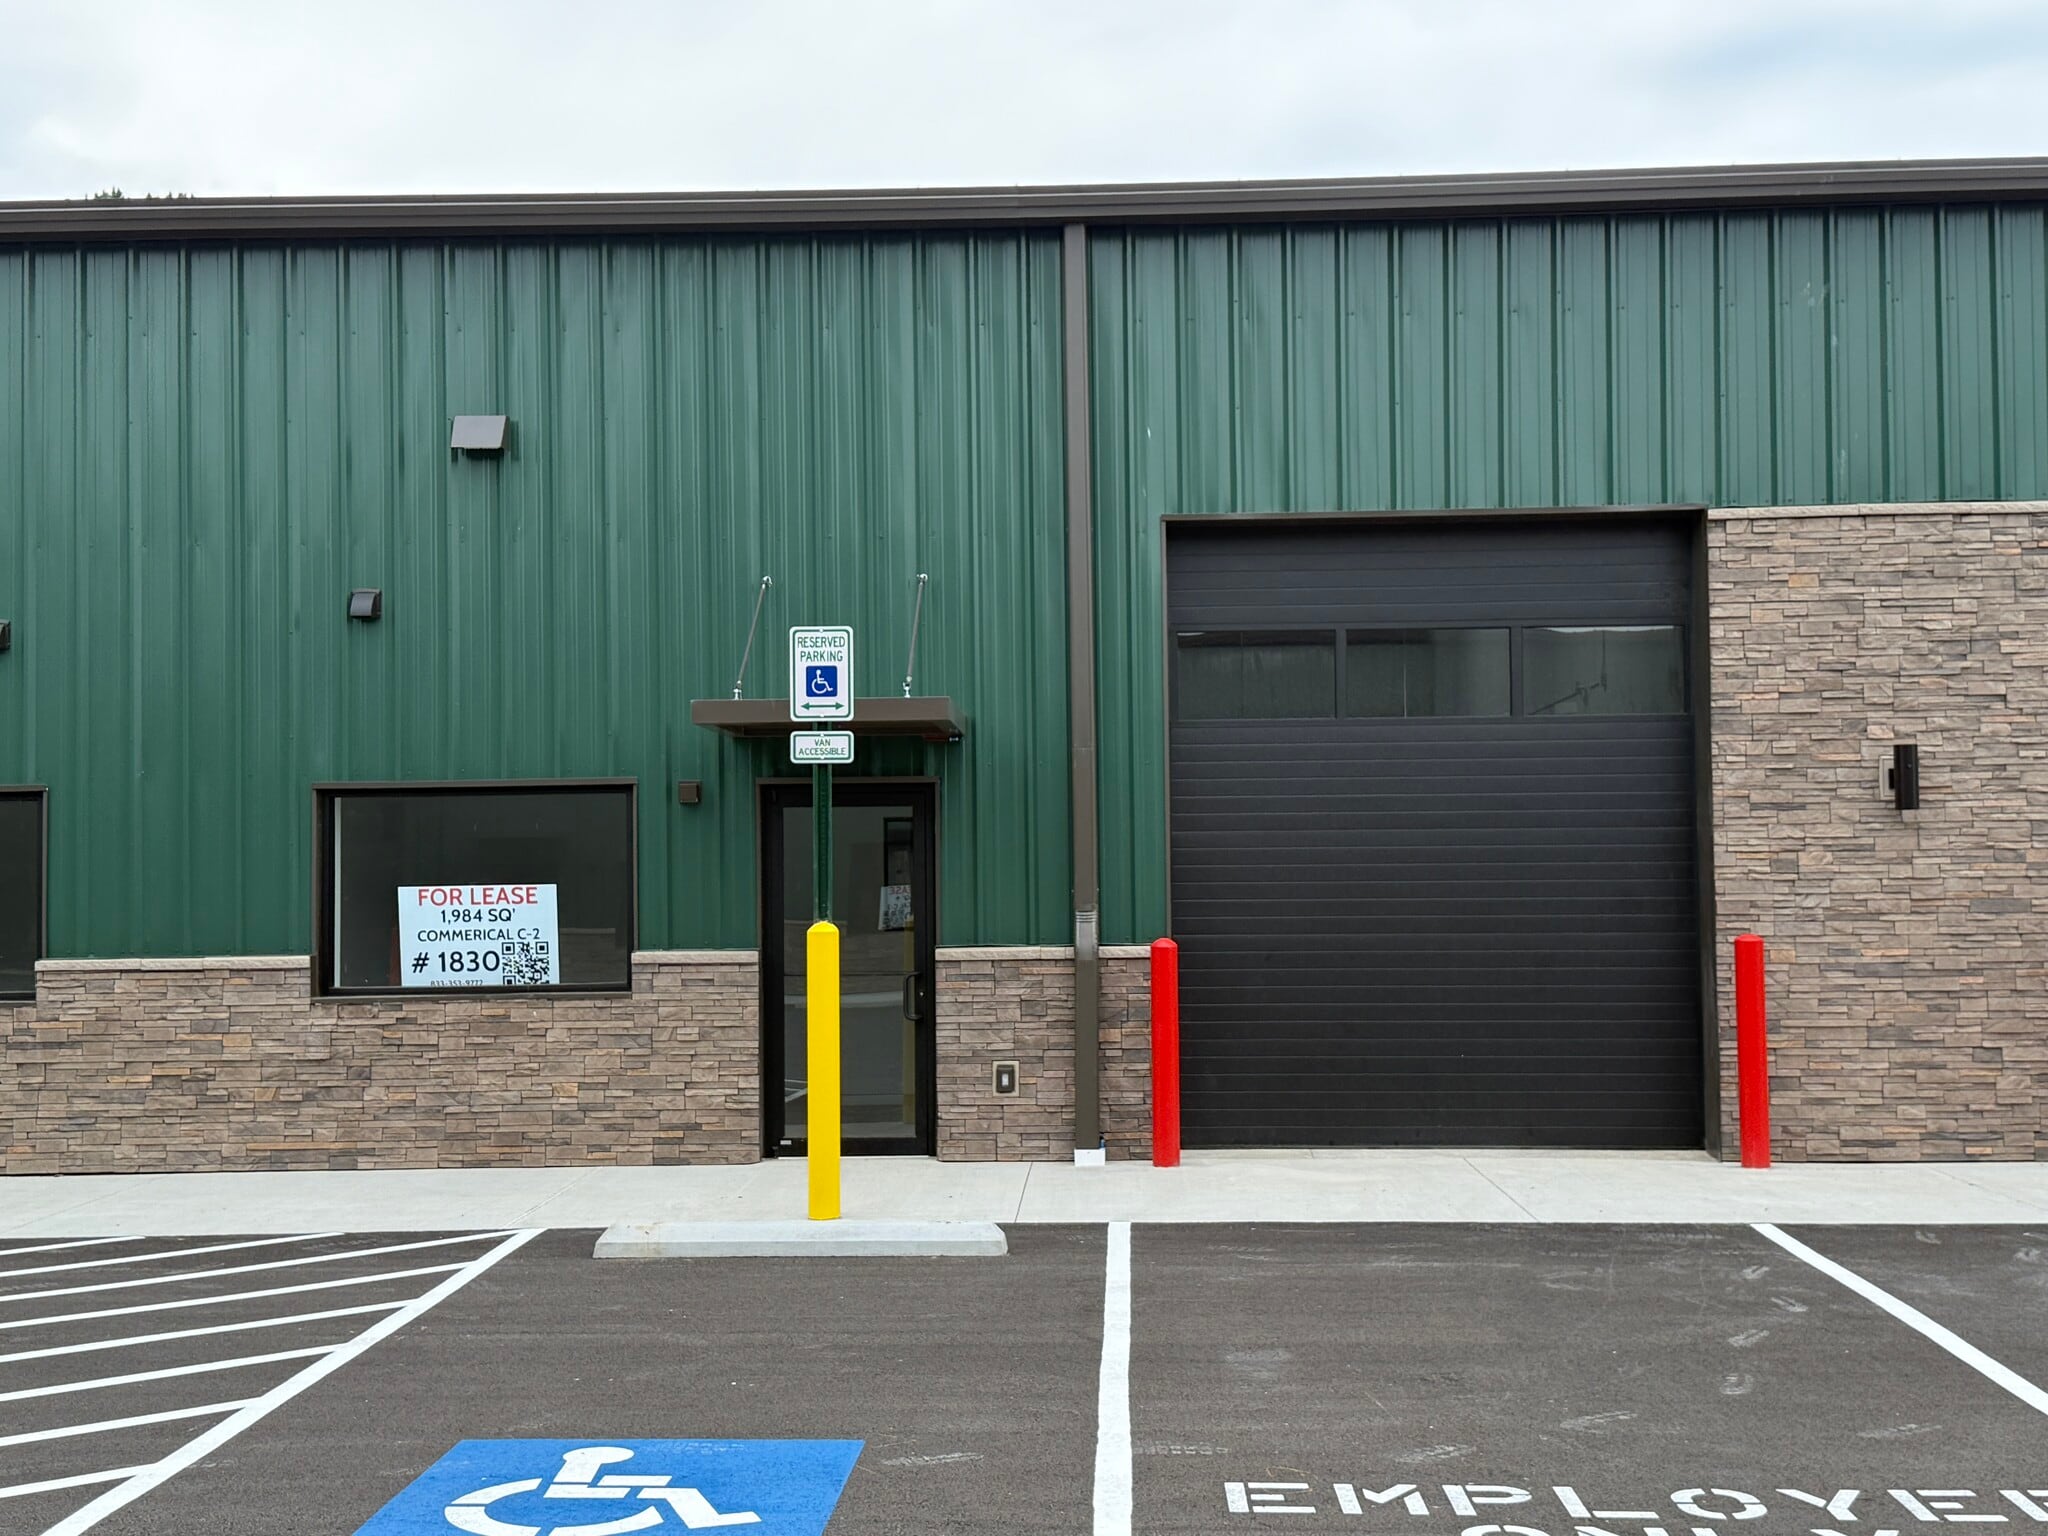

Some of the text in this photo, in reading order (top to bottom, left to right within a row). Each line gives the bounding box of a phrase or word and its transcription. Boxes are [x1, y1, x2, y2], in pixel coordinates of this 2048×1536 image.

[797, 636, 846, 648] RESERVED
[800, 650, 843, 662] PARKING
[814, 738, 831, 746] VAN
[798, 747, 847, 756] ACCESSIBLE
[418, 887, 538, 906] FOR LEASE
[440, 908, 516, 924] 1,984 SQ'
[417, 928, 541, 942] COMMERICAL C-2
[411, 951, 500, 973] # 1830
